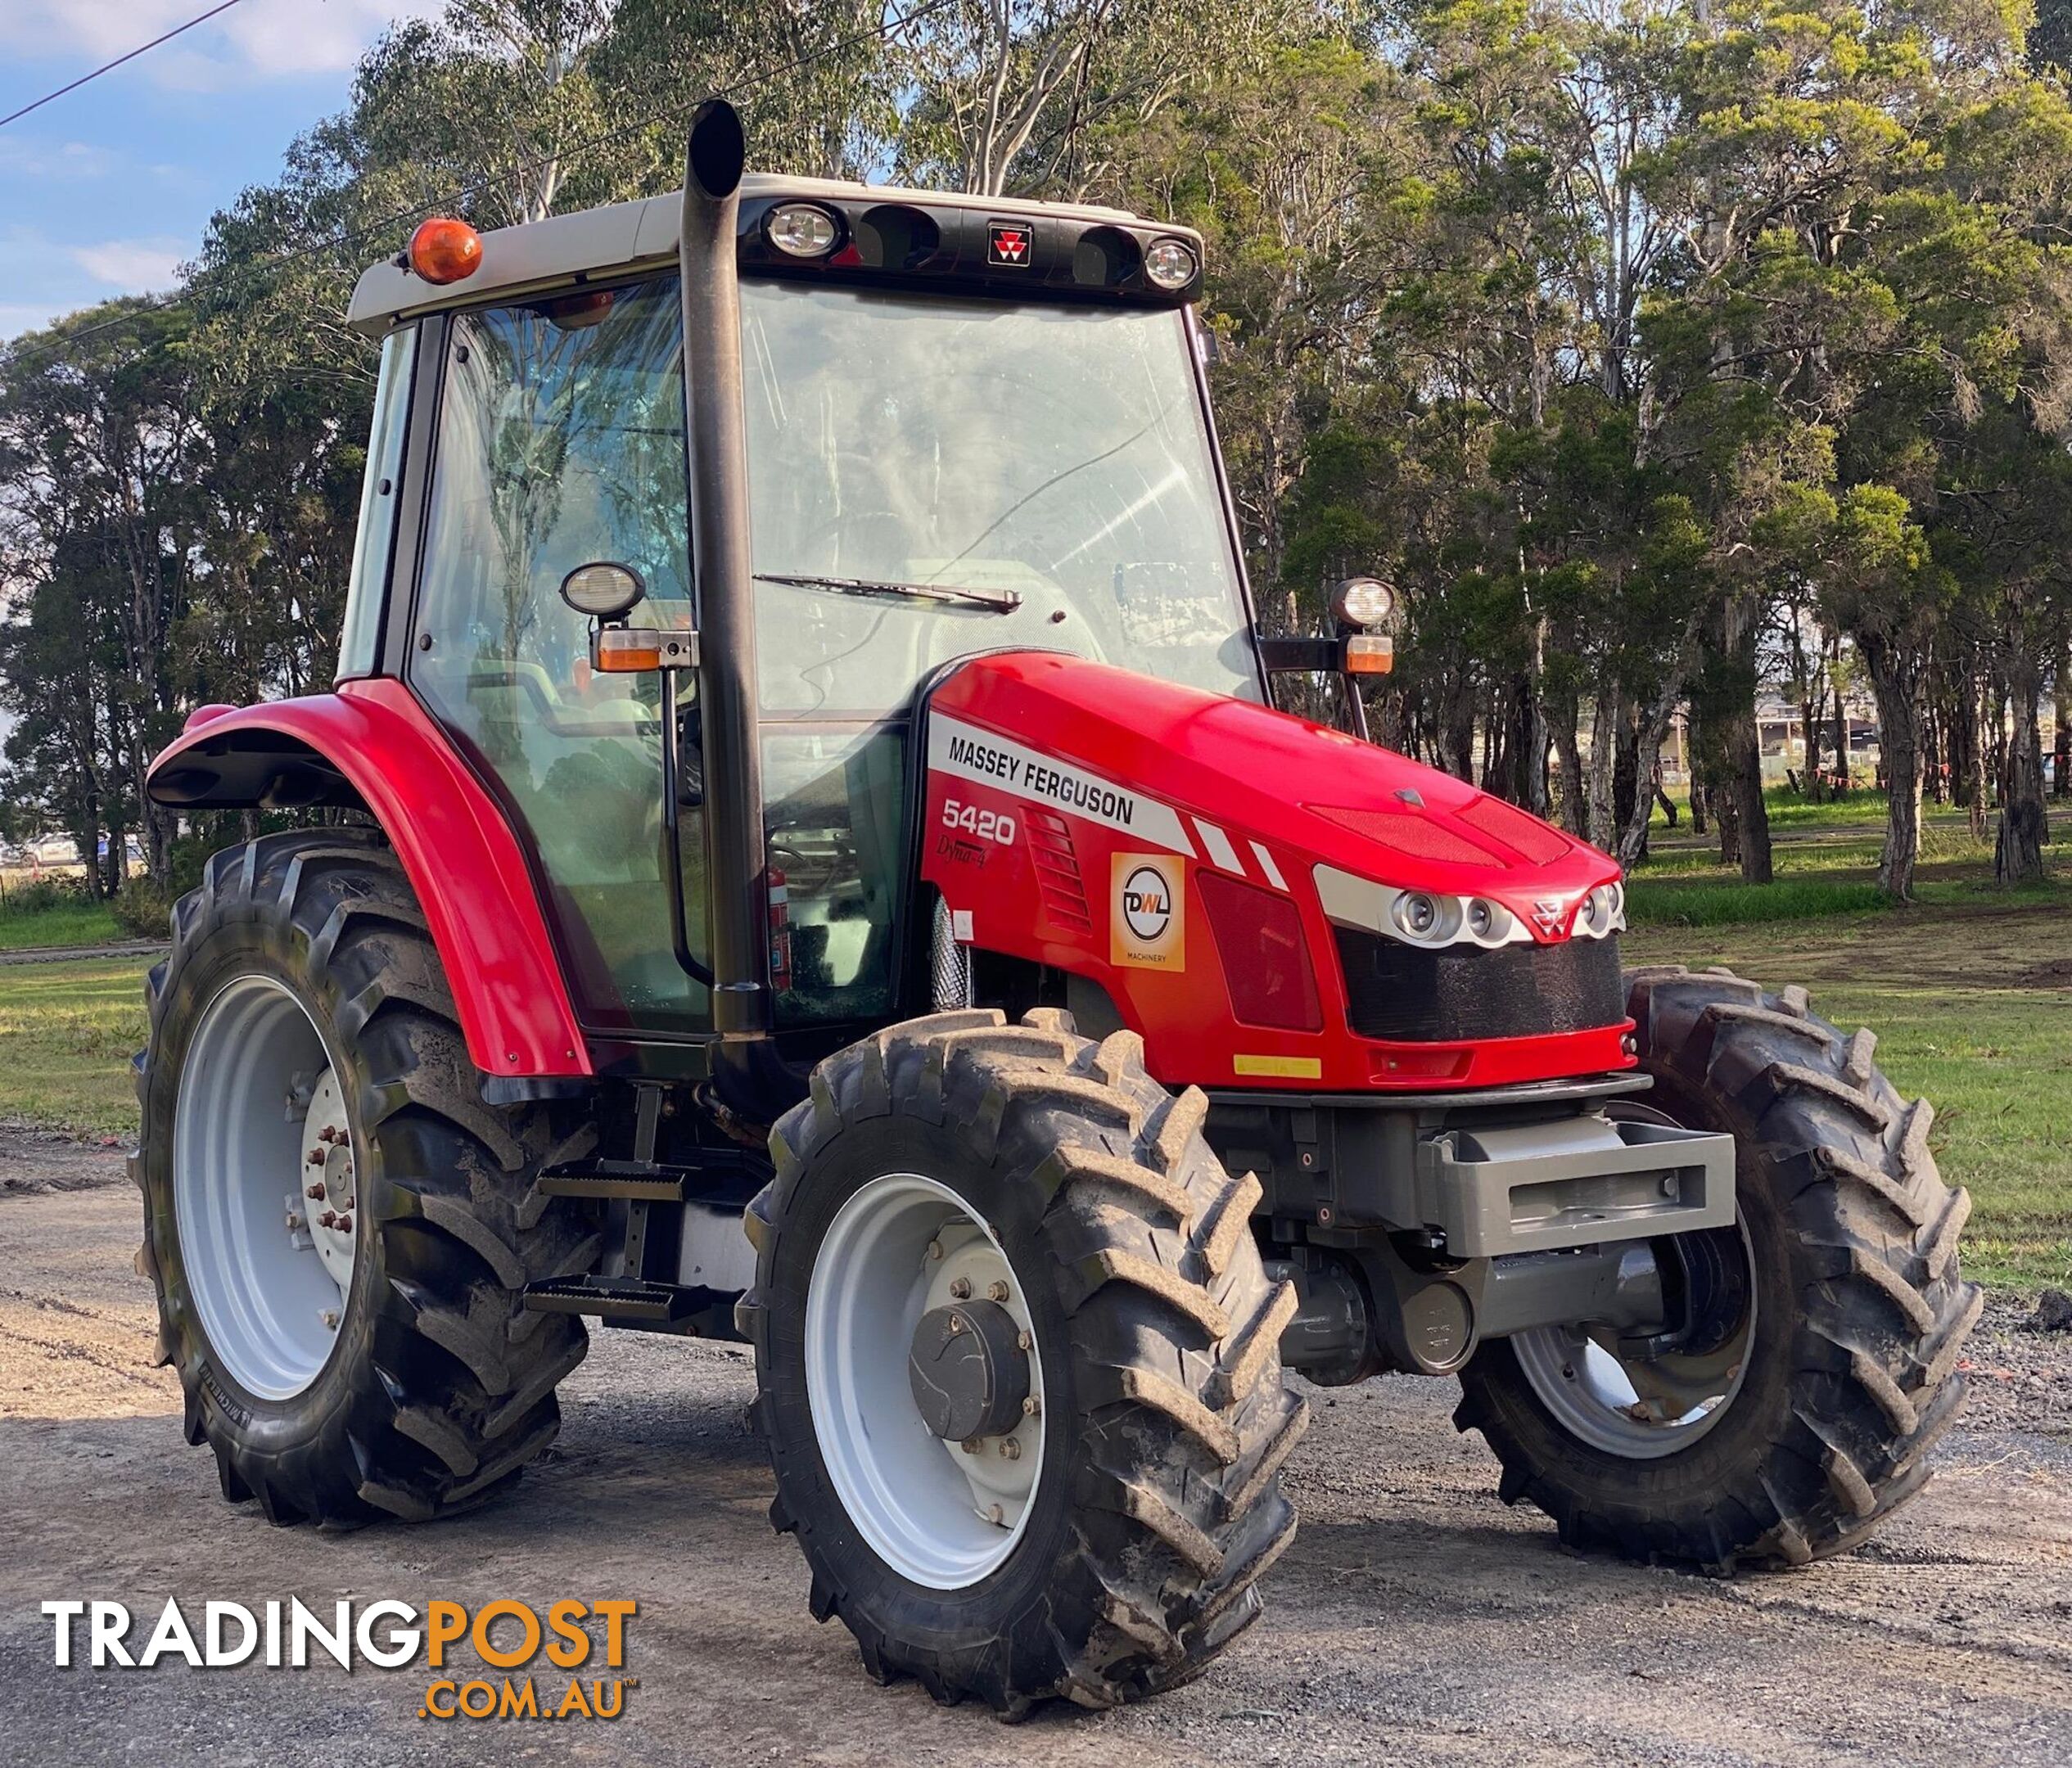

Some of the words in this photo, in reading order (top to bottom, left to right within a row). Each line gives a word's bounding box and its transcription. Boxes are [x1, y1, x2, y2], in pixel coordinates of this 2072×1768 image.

[949, 736, 1020, 781] MASSEY
[1023, 763, 1134, 825] FERGUSON
[941, 798, 1016, 846] 5420
[1123, 891, 1171, 915] DWL
[1126, 952, 1167, 963] MACHINERY
